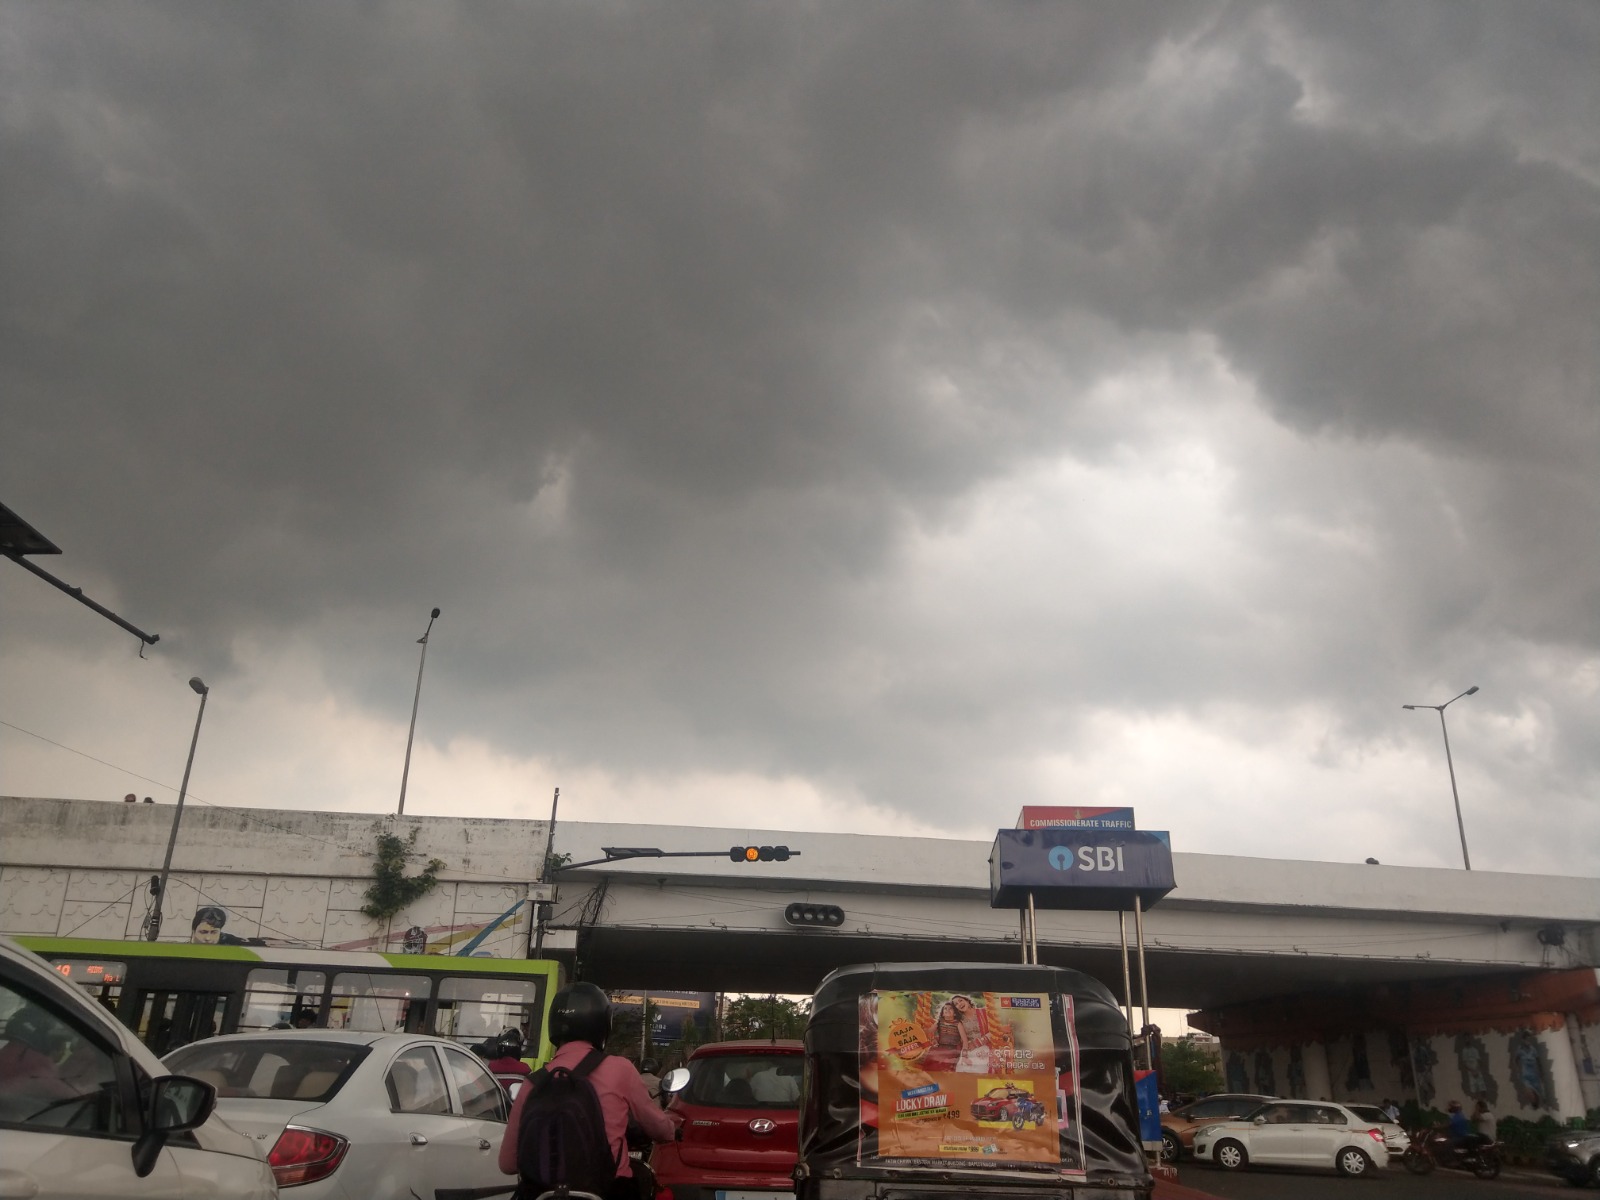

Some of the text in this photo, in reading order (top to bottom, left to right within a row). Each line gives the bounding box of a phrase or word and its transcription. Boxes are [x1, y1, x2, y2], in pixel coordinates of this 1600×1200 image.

[1030, 818, 1132, 828] COMMISSIONERATE TRAFFIC
[1078, 845, 1124, 872] SBI
[893, 1025, 914, 1037] RAJA
[897, 1034, 918, 1047] SAJA
[900, 1042, 920, 1054] OFFER
[896, 1094, 948, 1112] LUCKY DRAW
